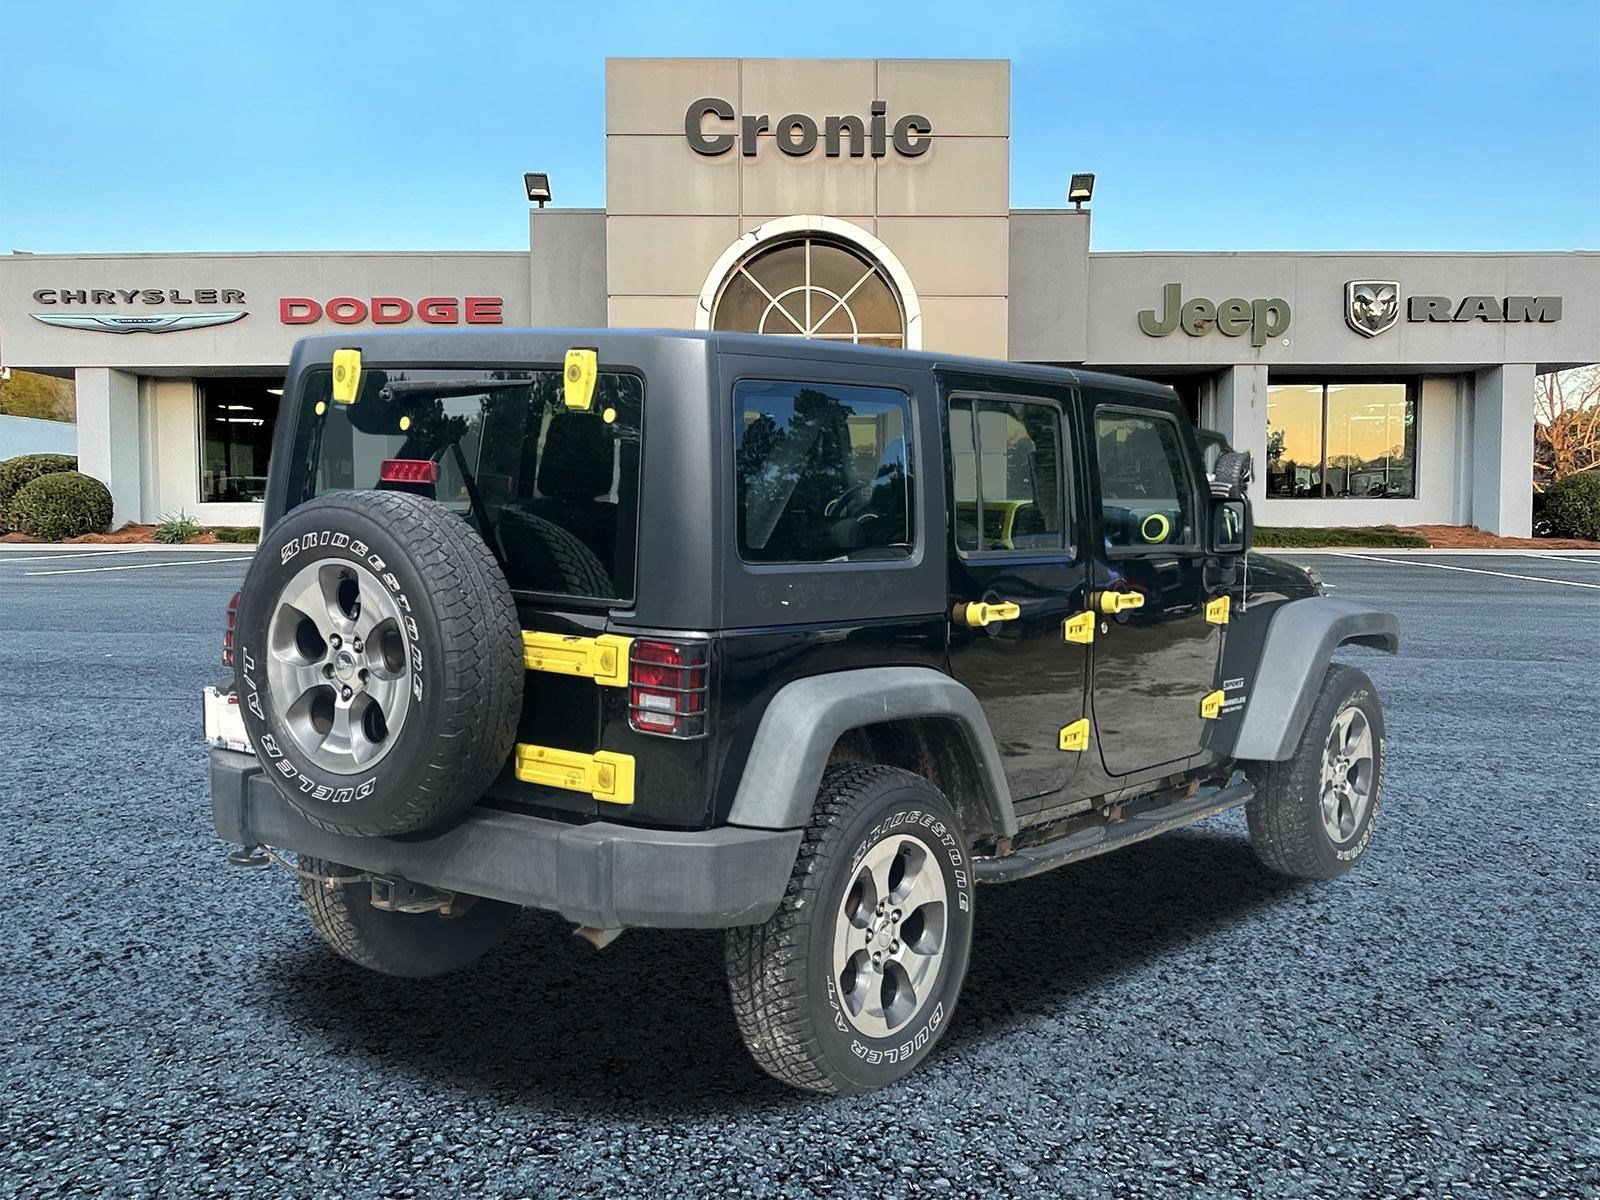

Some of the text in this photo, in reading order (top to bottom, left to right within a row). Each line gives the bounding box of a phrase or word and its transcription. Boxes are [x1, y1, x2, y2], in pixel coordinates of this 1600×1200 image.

[684, 97, 932, 157] Cronic
[32, 288, 247, 305] CHRYSLER
[279, 297, 505, 325] DODGE
[1138, 283, 1291, 348] Jeep
[1407, 295, 1563, 323] RAM
[280, 531, 424, 703] BRIDGESTONE
[1223, 678, 1244, 690] SPORT
[240, 646, 378, 803] DUELER A/T
[851, 810, 969, 914] BRIDGESTONE
[825, 975, 945, 1065] DUELER A/T
